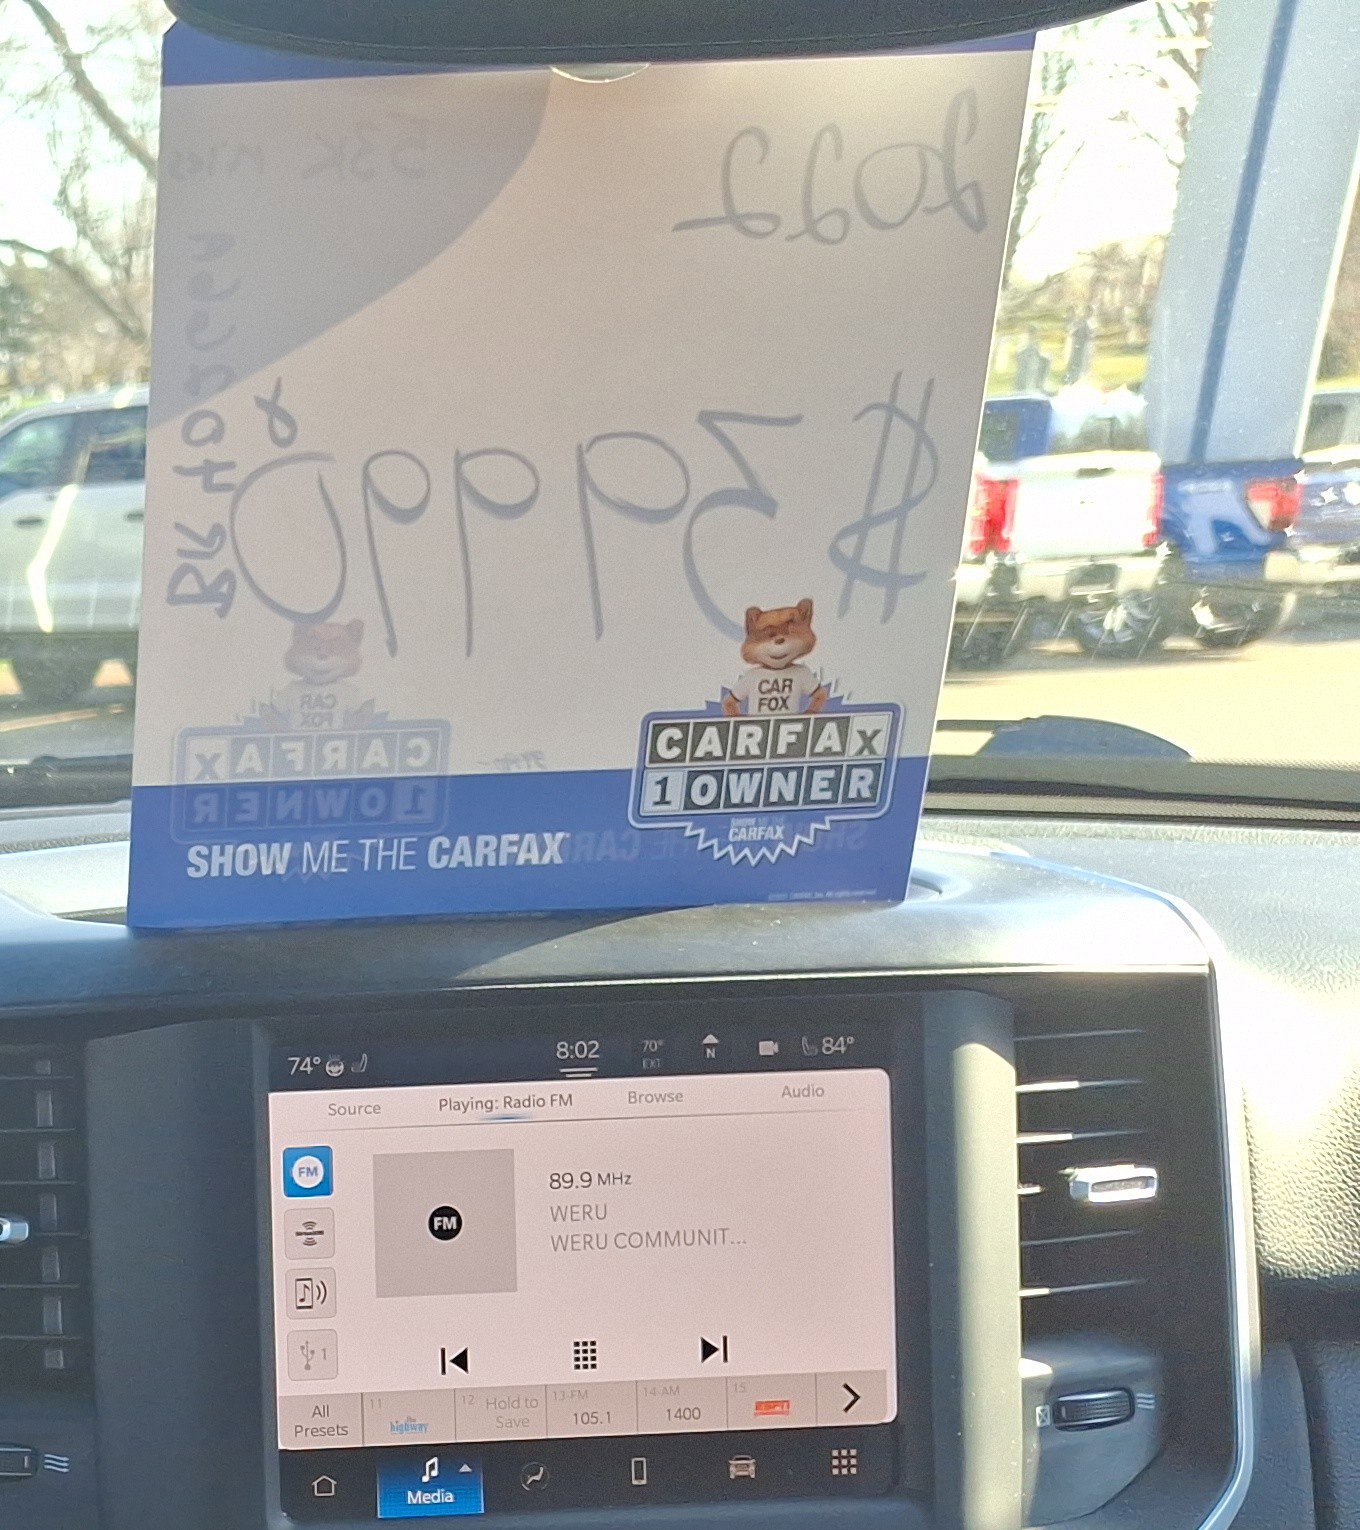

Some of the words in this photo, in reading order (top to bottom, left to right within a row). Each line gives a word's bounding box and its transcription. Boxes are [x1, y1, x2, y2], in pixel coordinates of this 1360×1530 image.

[757, 678, 794, 695] CAR
[757, 696, 791, 712] FOX
[655, 720, 883, 760] CARFAX
[652, 776, 672, 806] 1
[689, 767, 876, 806] OWNER
[186, 841, 293, 878] SHOW
[302, 840, 350, 873] ME
[359, 838, 418, 871] THE
[427, 832, 567, 869] CARFAX
[556, 1040, 600, 1060] 8:02
[706, 1047, 716, 1058] N
[821, 1036, 856, 1055] 84°
[287, 1056, 322, 1075] 74°
[627, 1090, 684, 1105] Browse
[781, 1084, 825, 1099] Audio
[328, 1102, 381, 1117] Source
[439, 1098, 499, 1114] Playing:
[503, 1095, 546, 1110] Radio
[550, 1093, 574, 1107] FM
[298, 1166, 319, 1178] FM
[549, 1171, 593, 1190] 89.9
[597, 1172, 632, 1186] MHz
[550, 1203, 608, 1223] WERU
[433, 1216, 458, 1231] FM
[550, 1233, 608, 1252] WERU
[733, 1381, 747, 1394] 15
[370, 1398, 383, 1410] 11
[461, 1393, 476, 1406] 12
[486, 1395, 520, 1411] Hold
[524, 1396, 539, 1410] to
[311, 1404, 331, 1419] All
[572, 1410, 612, 1427] 105.1
[666, 1406, 701, 1422] 1400
[294, 1422, 349, 1438] Presets
[390, 1420, 429, 1435] highway
[495, 1415, 530, 1430] Save
[407, 1489, 454, 1506] Media
